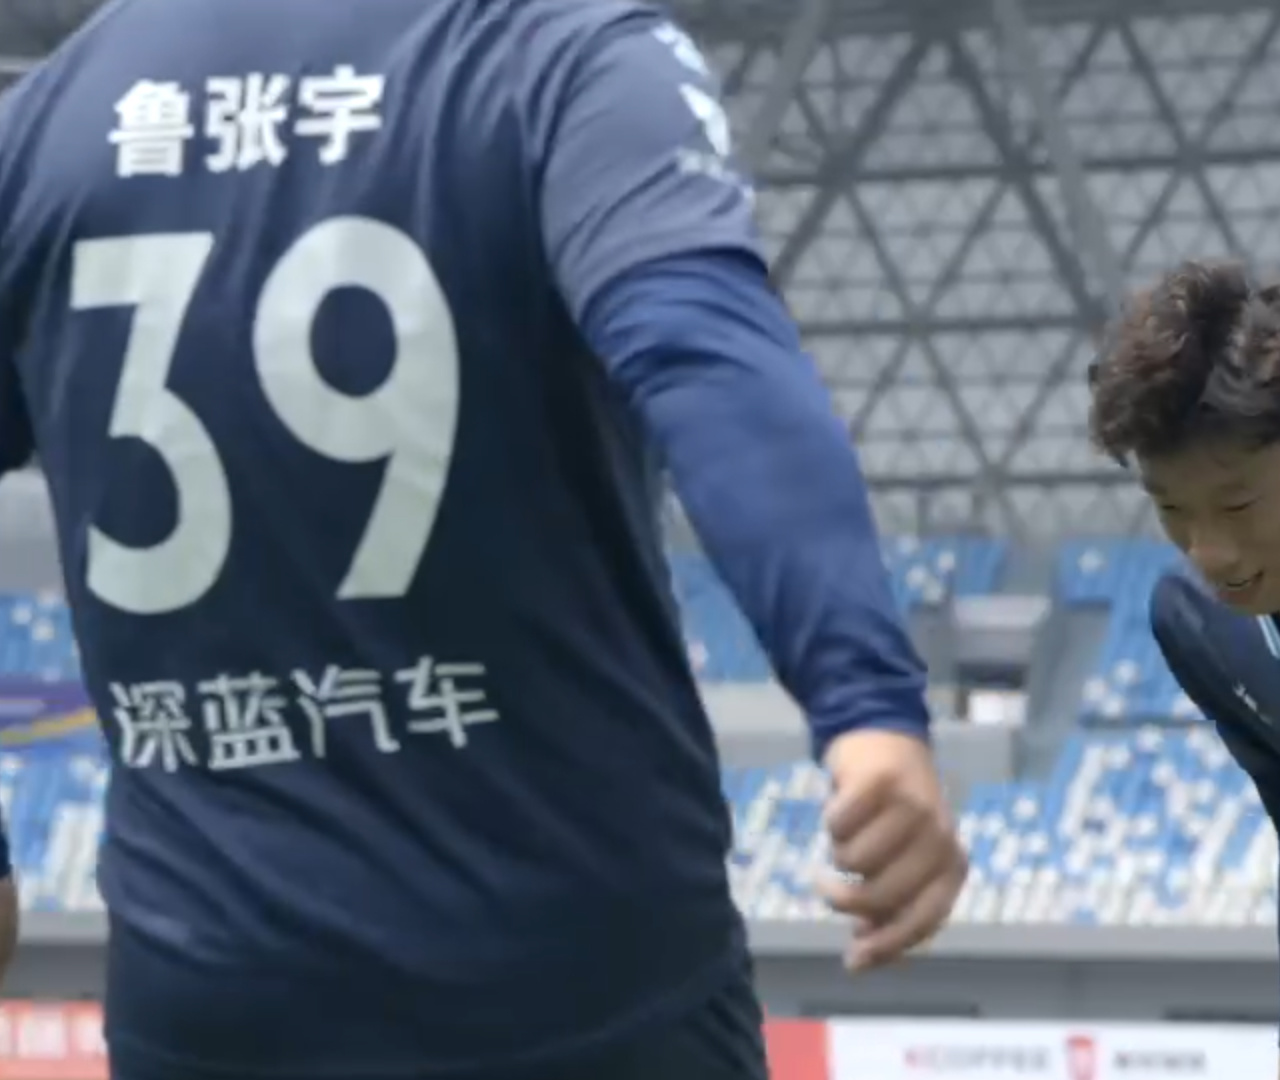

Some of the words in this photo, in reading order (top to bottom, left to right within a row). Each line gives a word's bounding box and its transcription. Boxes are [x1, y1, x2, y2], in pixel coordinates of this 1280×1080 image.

[107, 66, 384, 178] 鲁张宇
[70, 215, 461, 614] 39
[109, 655, 498, 773] 深蓝汽车
